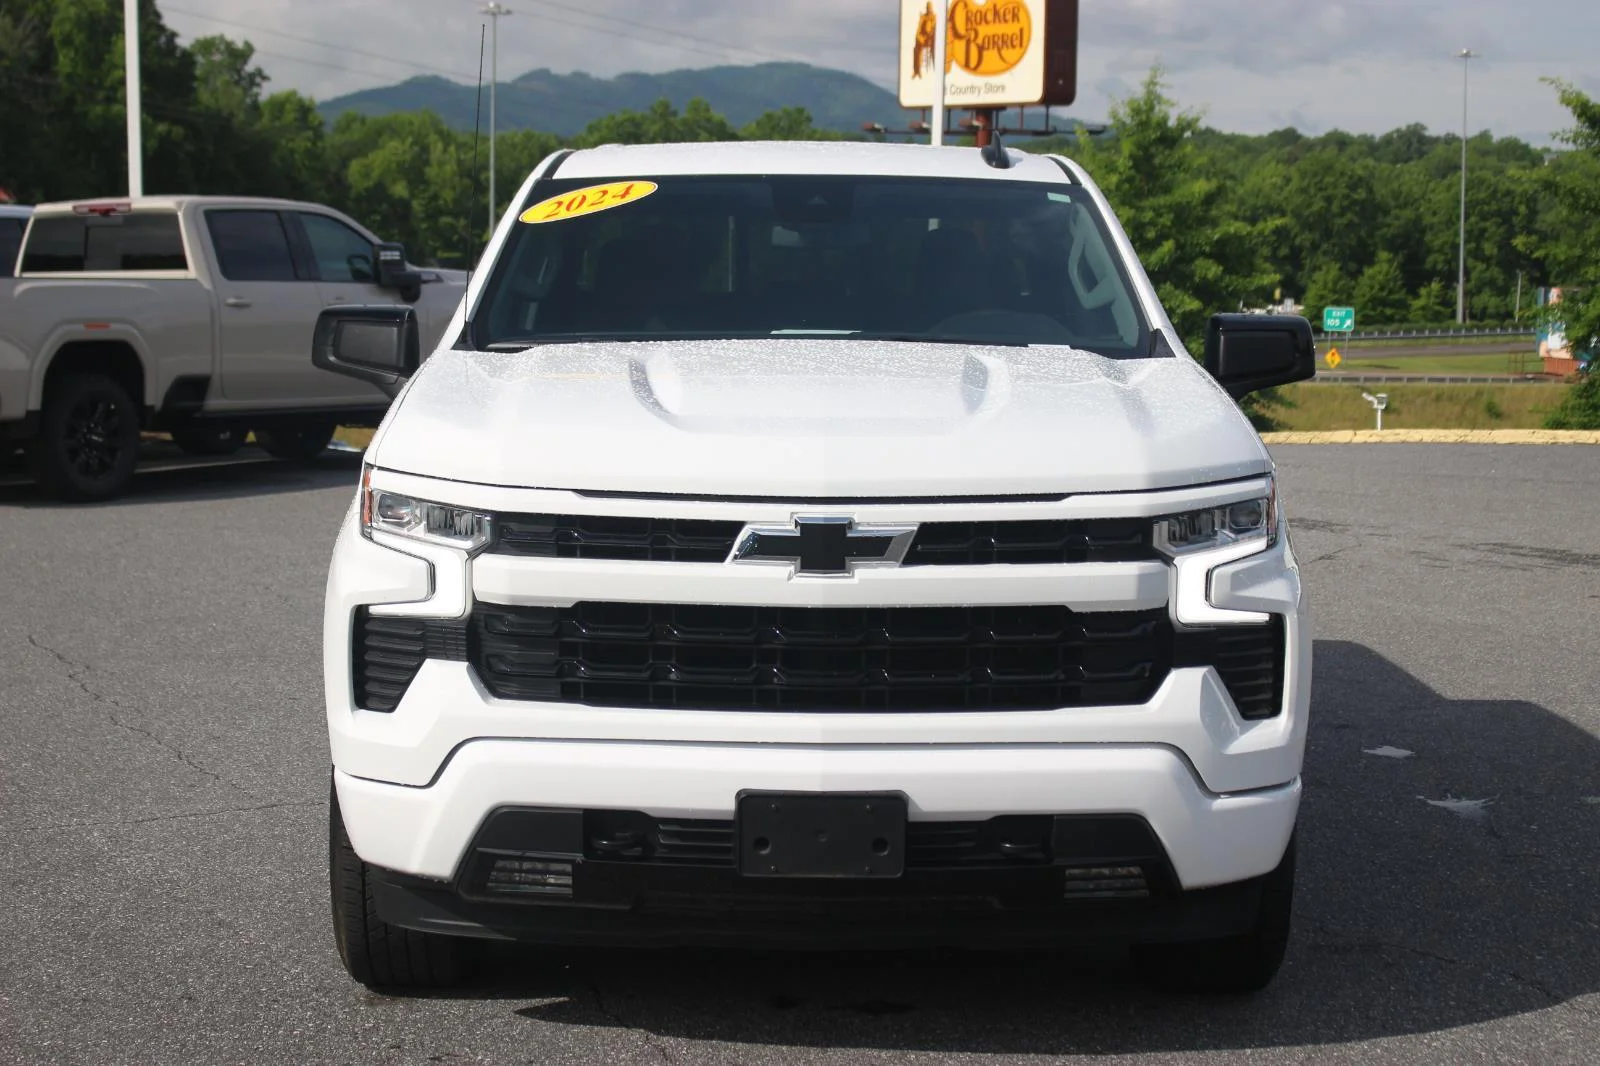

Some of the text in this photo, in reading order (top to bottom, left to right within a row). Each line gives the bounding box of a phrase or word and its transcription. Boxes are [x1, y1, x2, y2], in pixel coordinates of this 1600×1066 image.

[965, 27, 1023, 71] Barrel
[950, 84, 981, 96] Country
[984, 82, 1006, 95] Store
[542, 183, 634, 219] 2024
